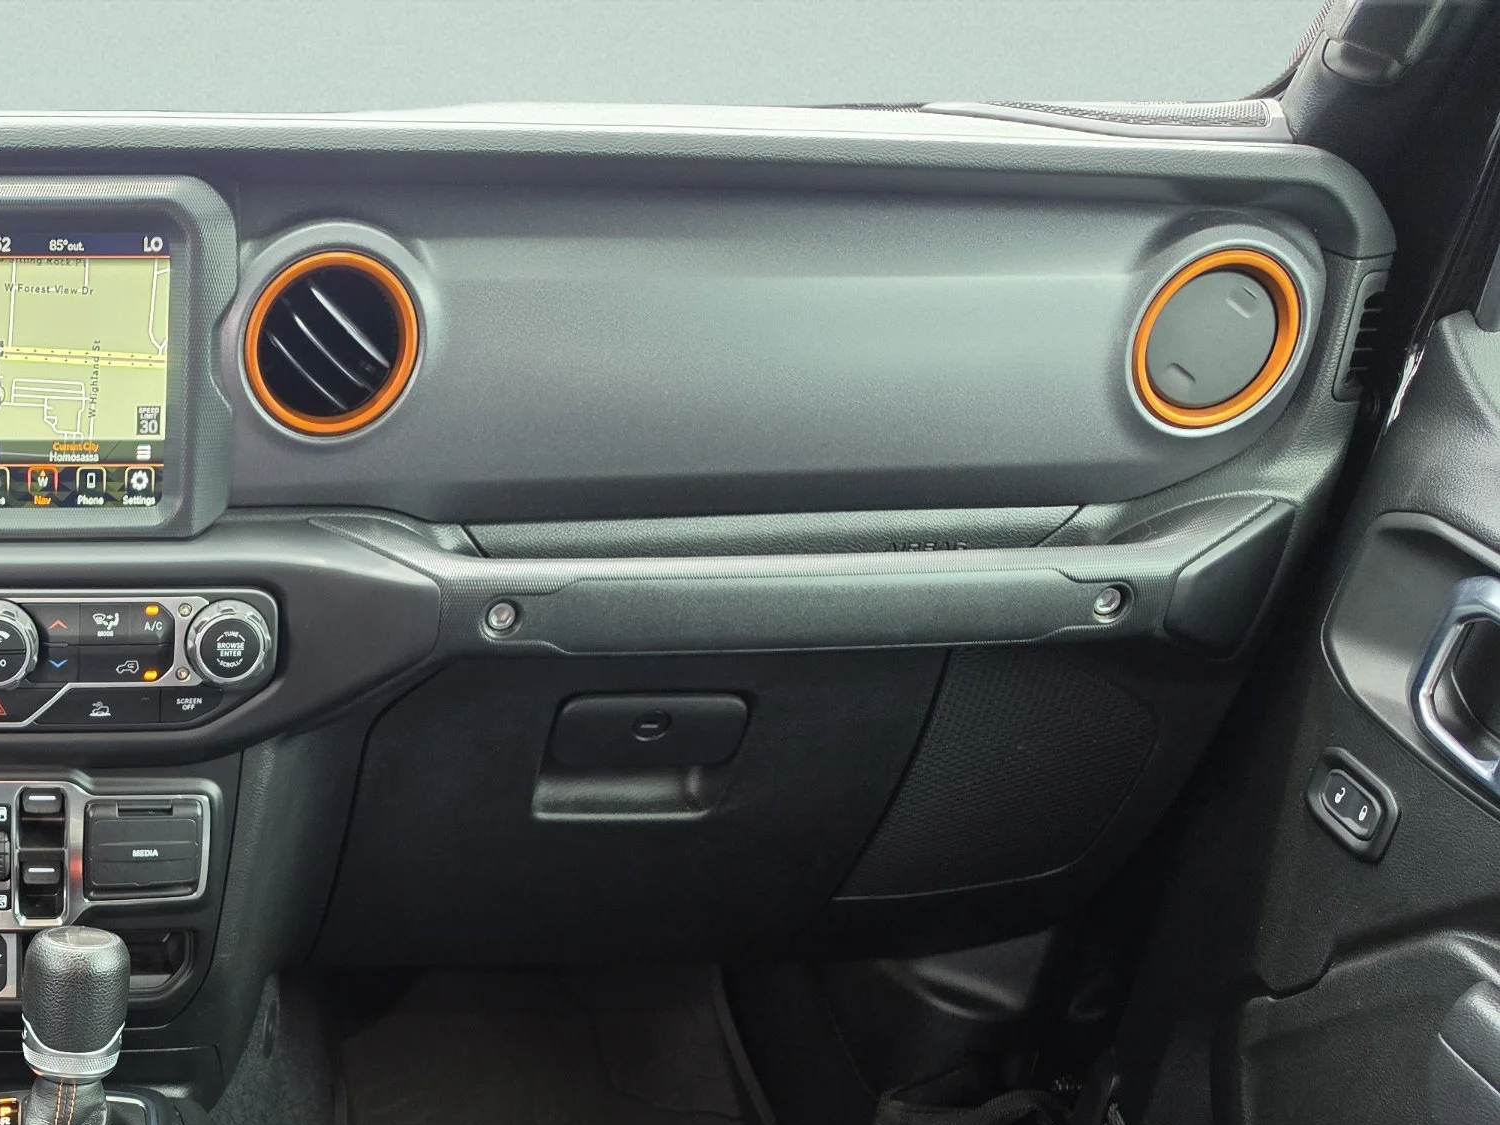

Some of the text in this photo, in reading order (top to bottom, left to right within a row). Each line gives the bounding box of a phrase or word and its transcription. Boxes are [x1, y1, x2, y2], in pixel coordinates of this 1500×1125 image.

[143, 235, 163, 252] LO
[4, 283, 93, 295] W Forest View Dr
[88, 340, 100, 418] W Highland St
[140, 420, 158, 434] 30
[53, 442, 99, 452] Current City
[50, 452, 99, 462] Homosassa
[34, 496, 51, 505] Nav
[77, 496, 104, 505] Phone
[123, 496, 155, 506] Settings
[144, 621, 162, 631] A/C
[219, 660, 241, 668] SCROLL
[132, 849, 158, 857] MEDIA
[0, 1107, 11, 1116] P
[0, 1116, 11, 1125] R
